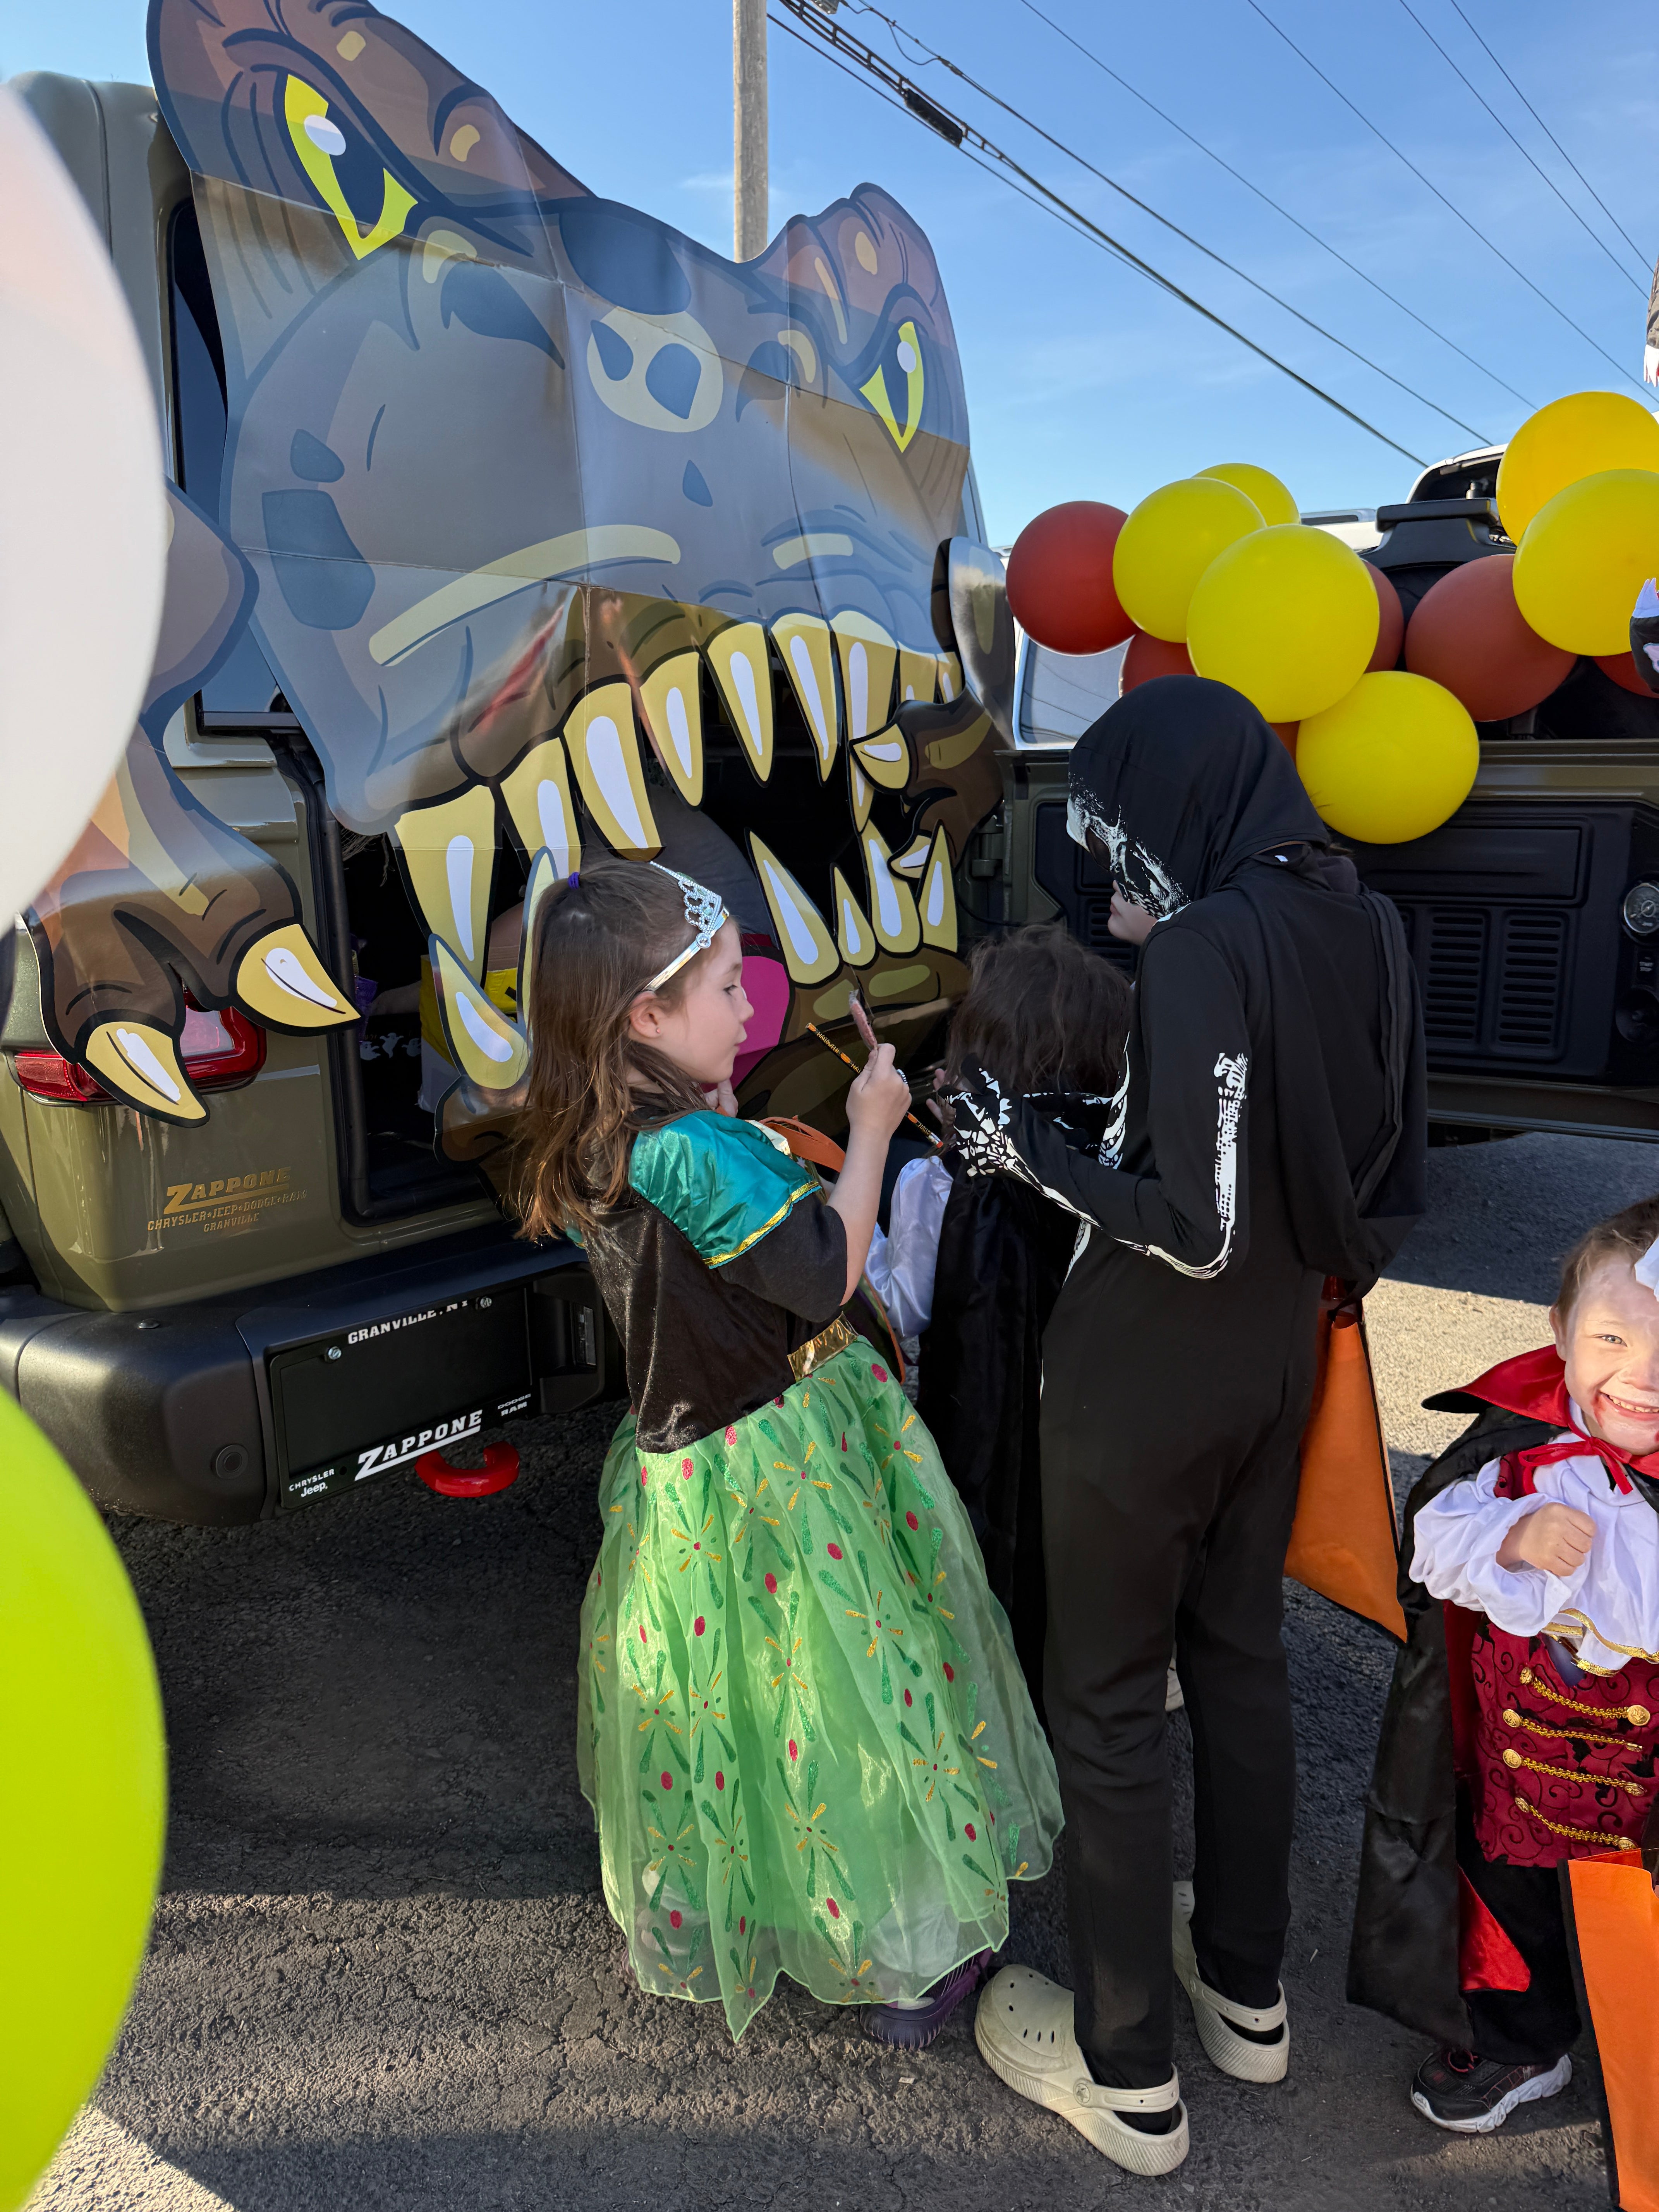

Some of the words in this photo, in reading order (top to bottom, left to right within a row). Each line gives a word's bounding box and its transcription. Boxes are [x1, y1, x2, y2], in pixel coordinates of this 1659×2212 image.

[817, 1032, 840, 1054] HALLOWEEN
[163, 1166, 291, 1215] ZAPPONE
[147, 1211, 206, 1231] CHRYSLER
[212, 1204, 237, 1219] JEEP
[244, 1195, 276, 1213] DODGE
[204, 1212, 260, 1233] GRANVILLE
[497, 1393, 531, 1410] DODGE
[501, 1401, 527, 1416] RAM
[354, 1409, 483, 1481] ZAPPONE
[289, 1468, 335, 1491] CHRYSLER
